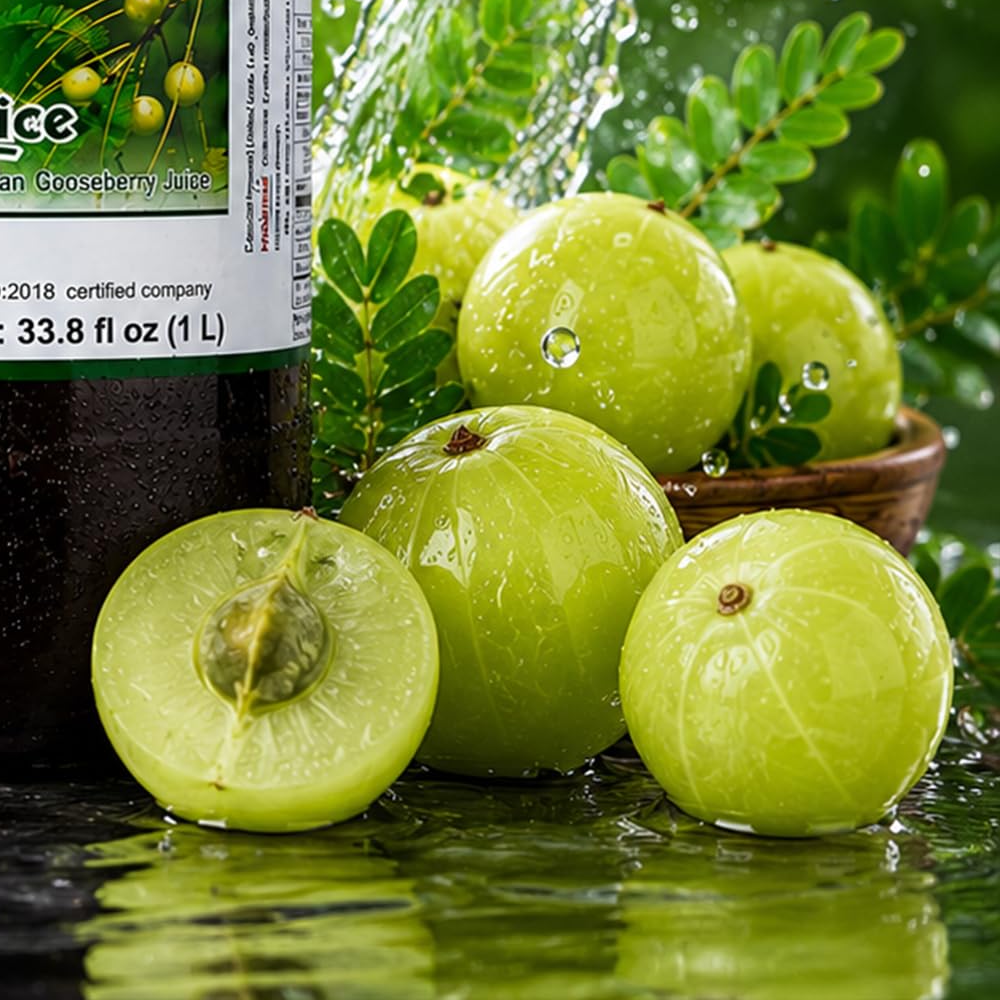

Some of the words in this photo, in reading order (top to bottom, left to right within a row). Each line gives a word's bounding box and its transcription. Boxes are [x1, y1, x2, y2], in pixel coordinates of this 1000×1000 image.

[35, 170, 156, 197] Gooseberry
[162, 169, 211, 191] Juice
[66, 281, 136, 300] certified
[141, 282, 213, 301] company
[17, 317, 84, 345] 33.8
[94, 317, 114, 344] fl
[123, 321, 160, 343] oz
[167, 313, 190, 350] (1
[201, 312, 225, 347] L)
